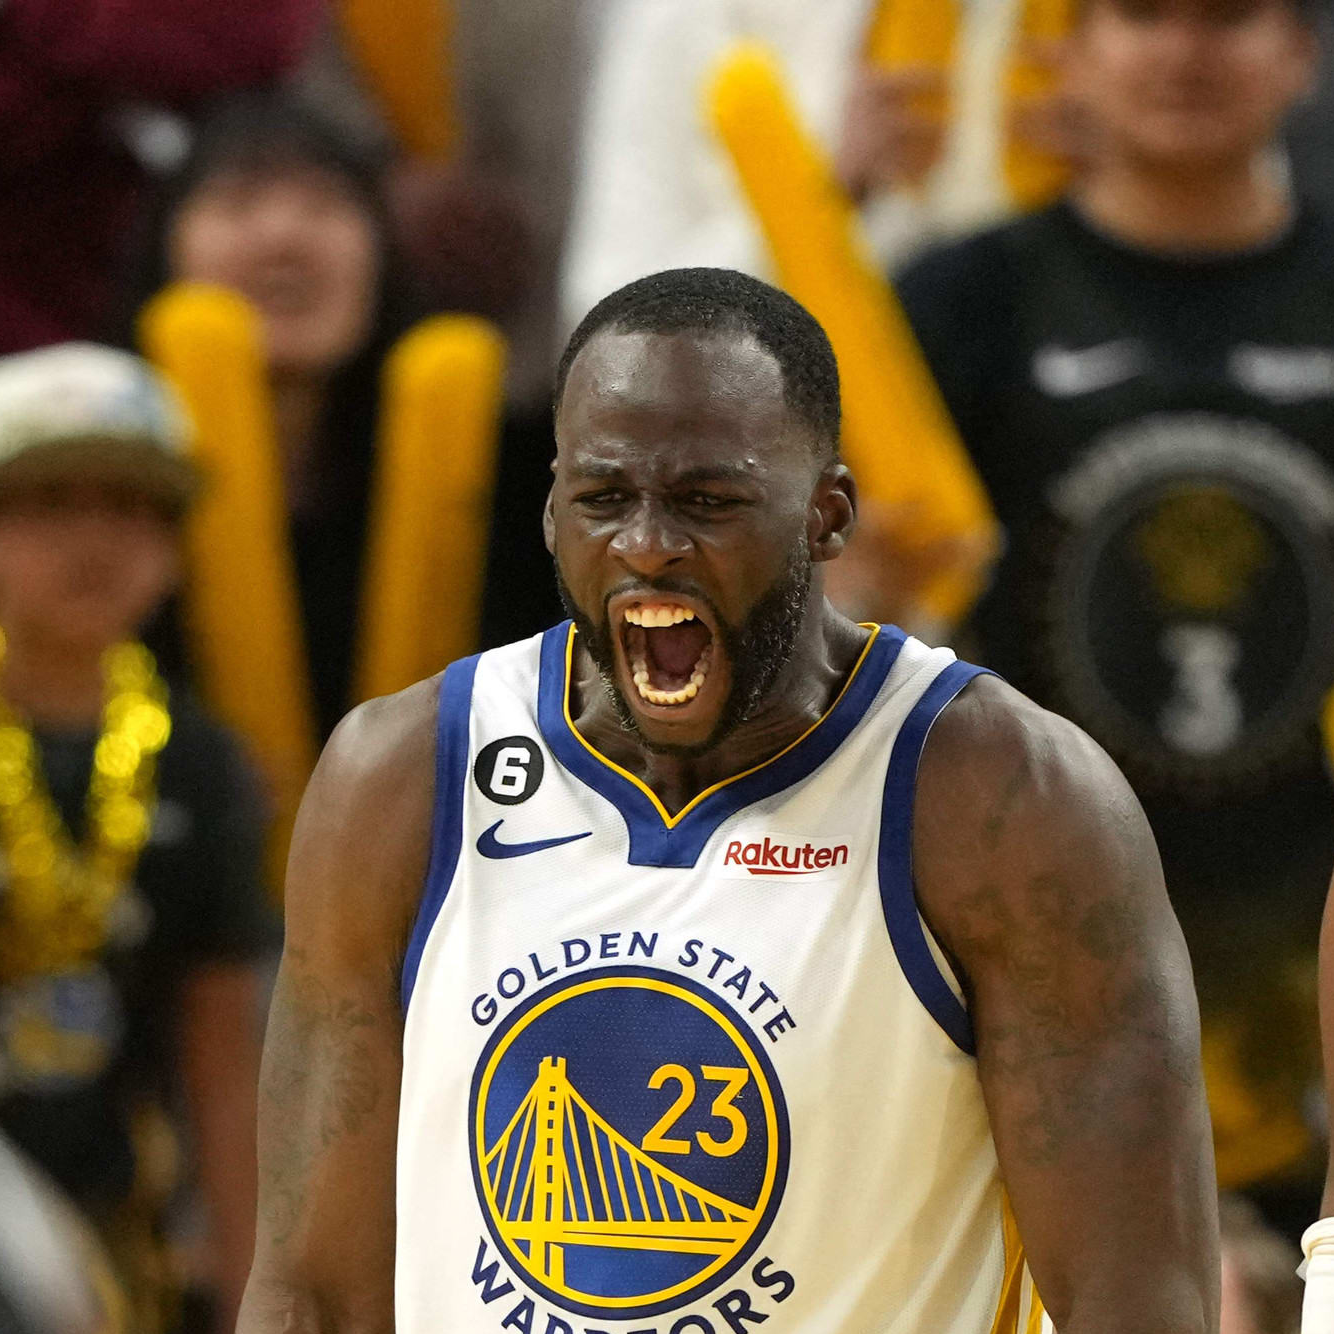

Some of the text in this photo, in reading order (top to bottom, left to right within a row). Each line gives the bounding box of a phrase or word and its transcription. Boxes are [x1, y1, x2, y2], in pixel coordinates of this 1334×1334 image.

[489, 745, 530, 796] 6
[724, 837, 849, 872] Rakuten
[471, 931, 798, 1045] GOLDEN STATE
[641, 1062, 750, 1160] 23
